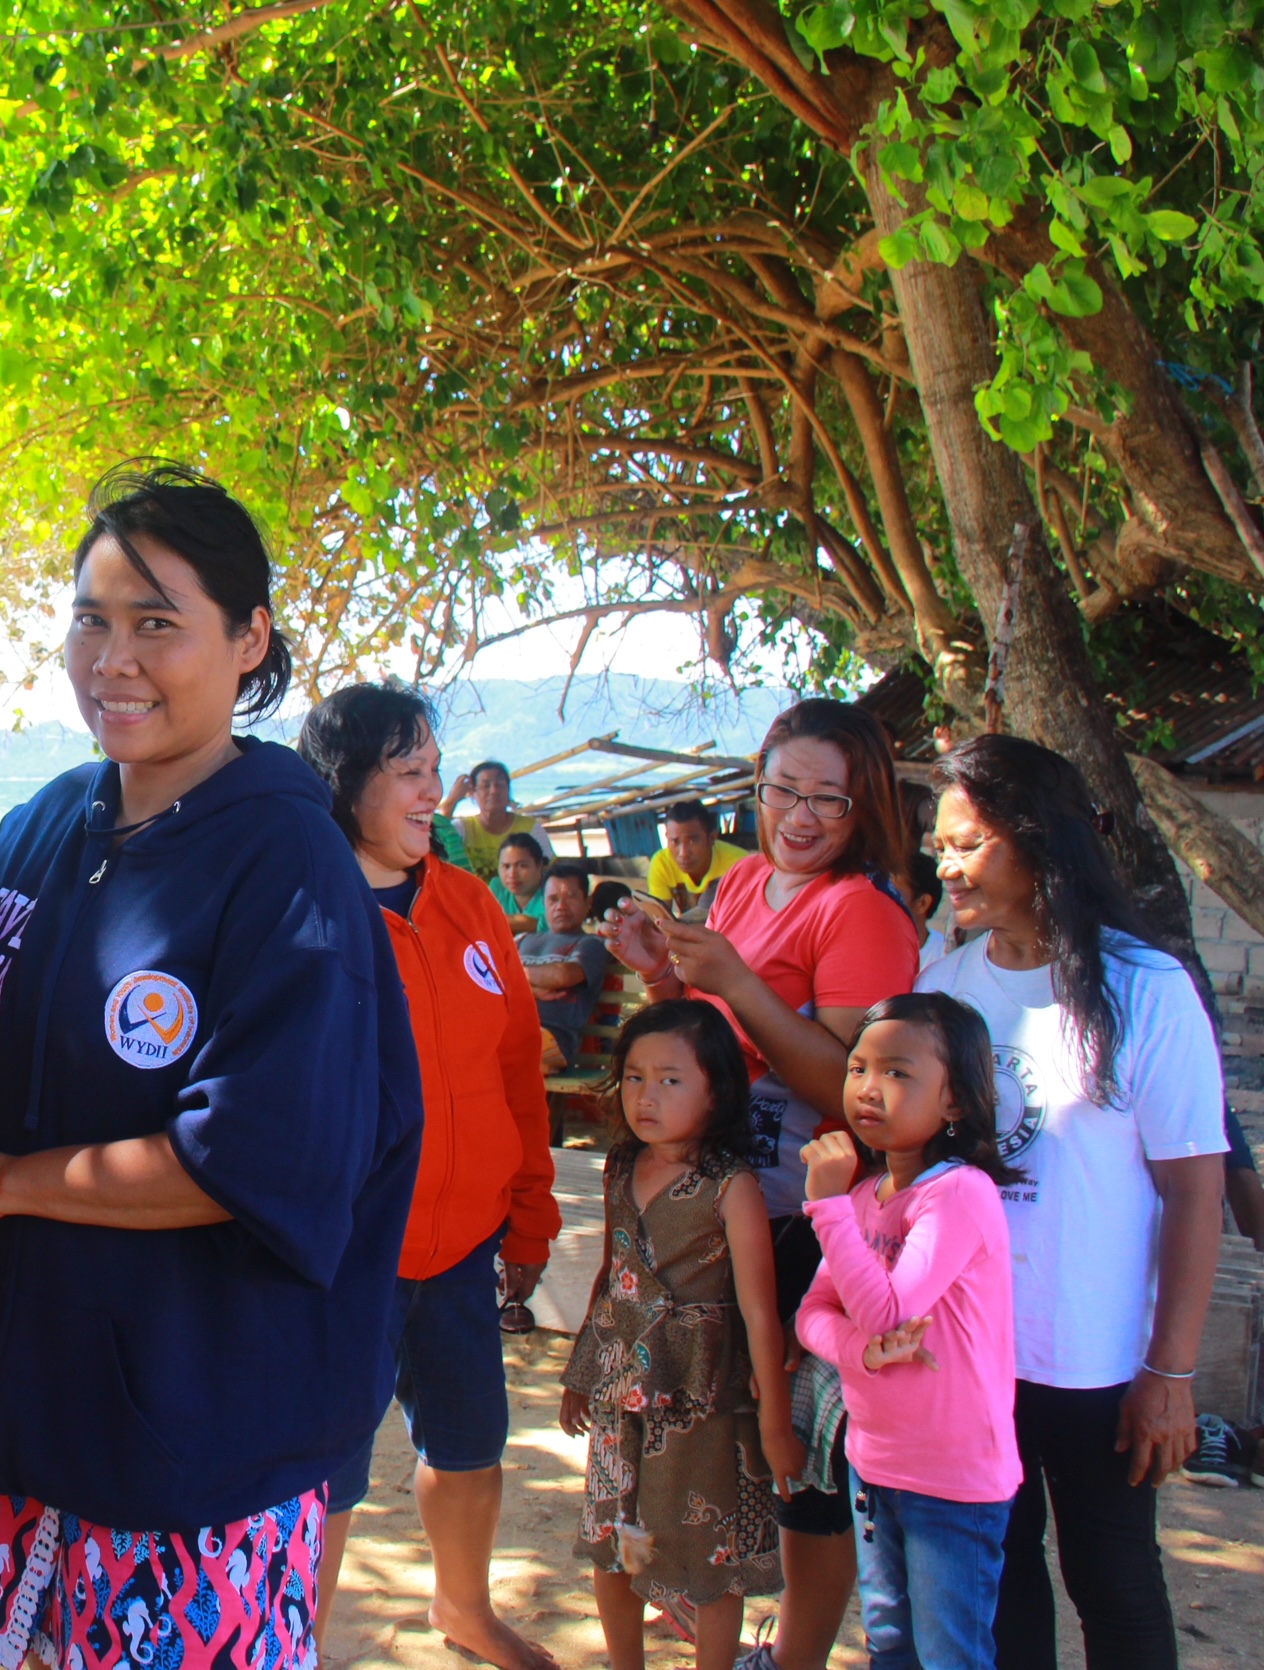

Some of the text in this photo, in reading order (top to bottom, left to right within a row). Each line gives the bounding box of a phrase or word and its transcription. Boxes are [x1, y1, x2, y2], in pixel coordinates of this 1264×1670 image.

[119, 1035, 170, 1059] WYDII
[992, 1053, 1039, 1097] ARTA
[1000, 1190, 1038, 1203] OVE ME
